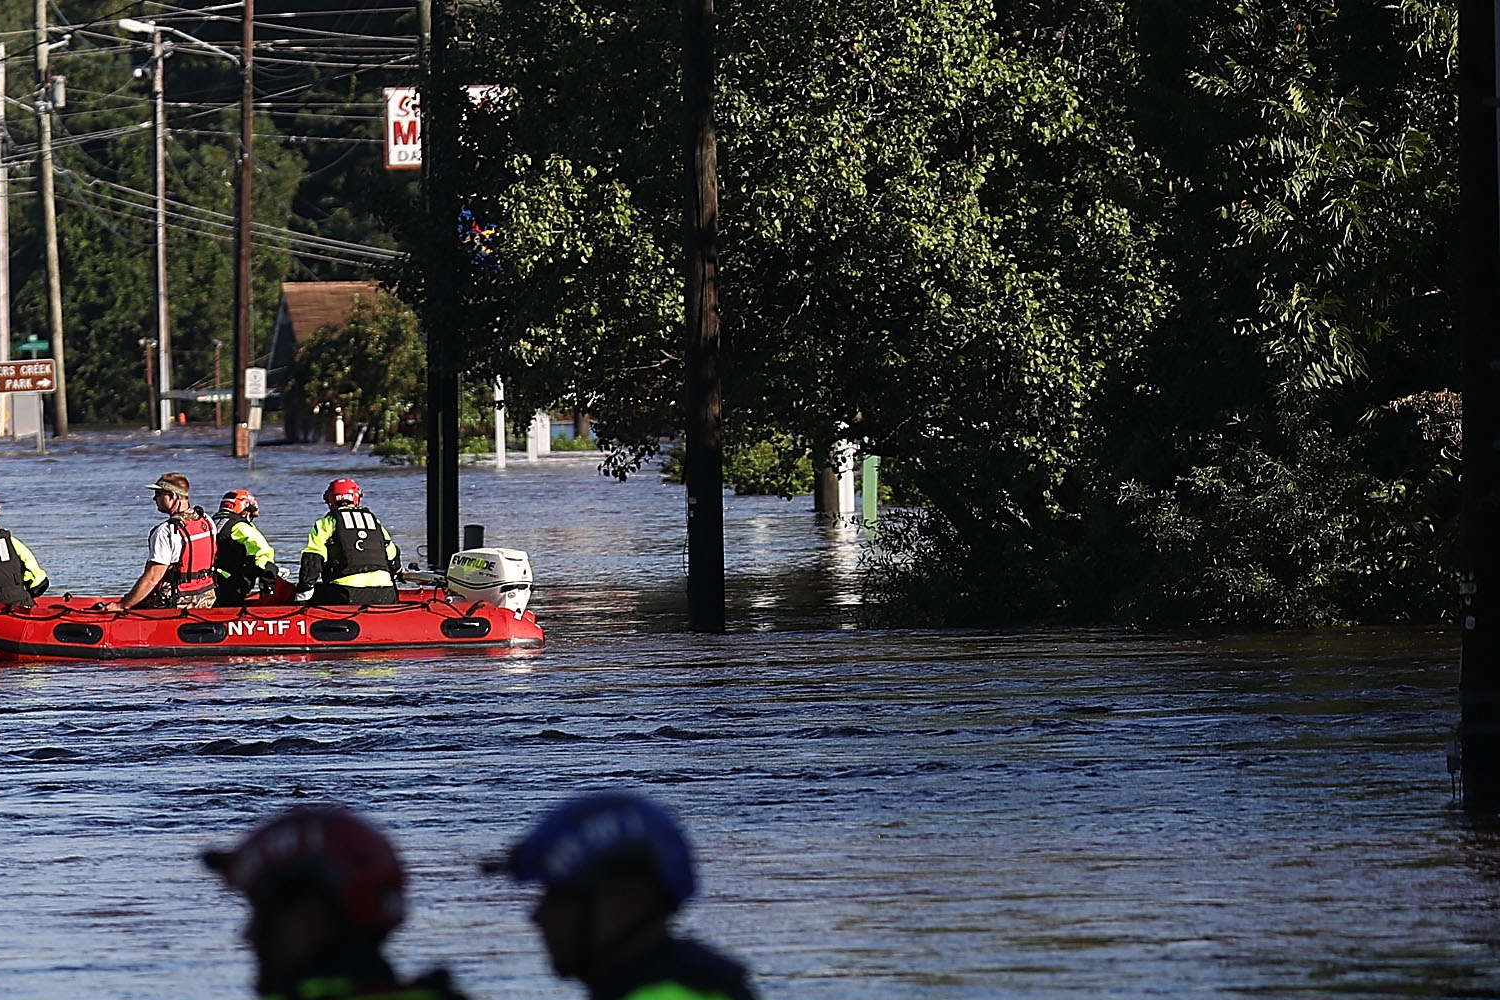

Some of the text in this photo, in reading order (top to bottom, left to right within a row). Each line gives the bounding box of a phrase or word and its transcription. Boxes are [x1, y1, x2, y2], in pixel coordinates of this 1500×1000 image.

[19, 364, 52, 376] CREEK
[5, 379, 33, 391] PARK
[452, 555, 497, 571] EVINRUDE
[228, 620, 307, 636] NY-TF 1
